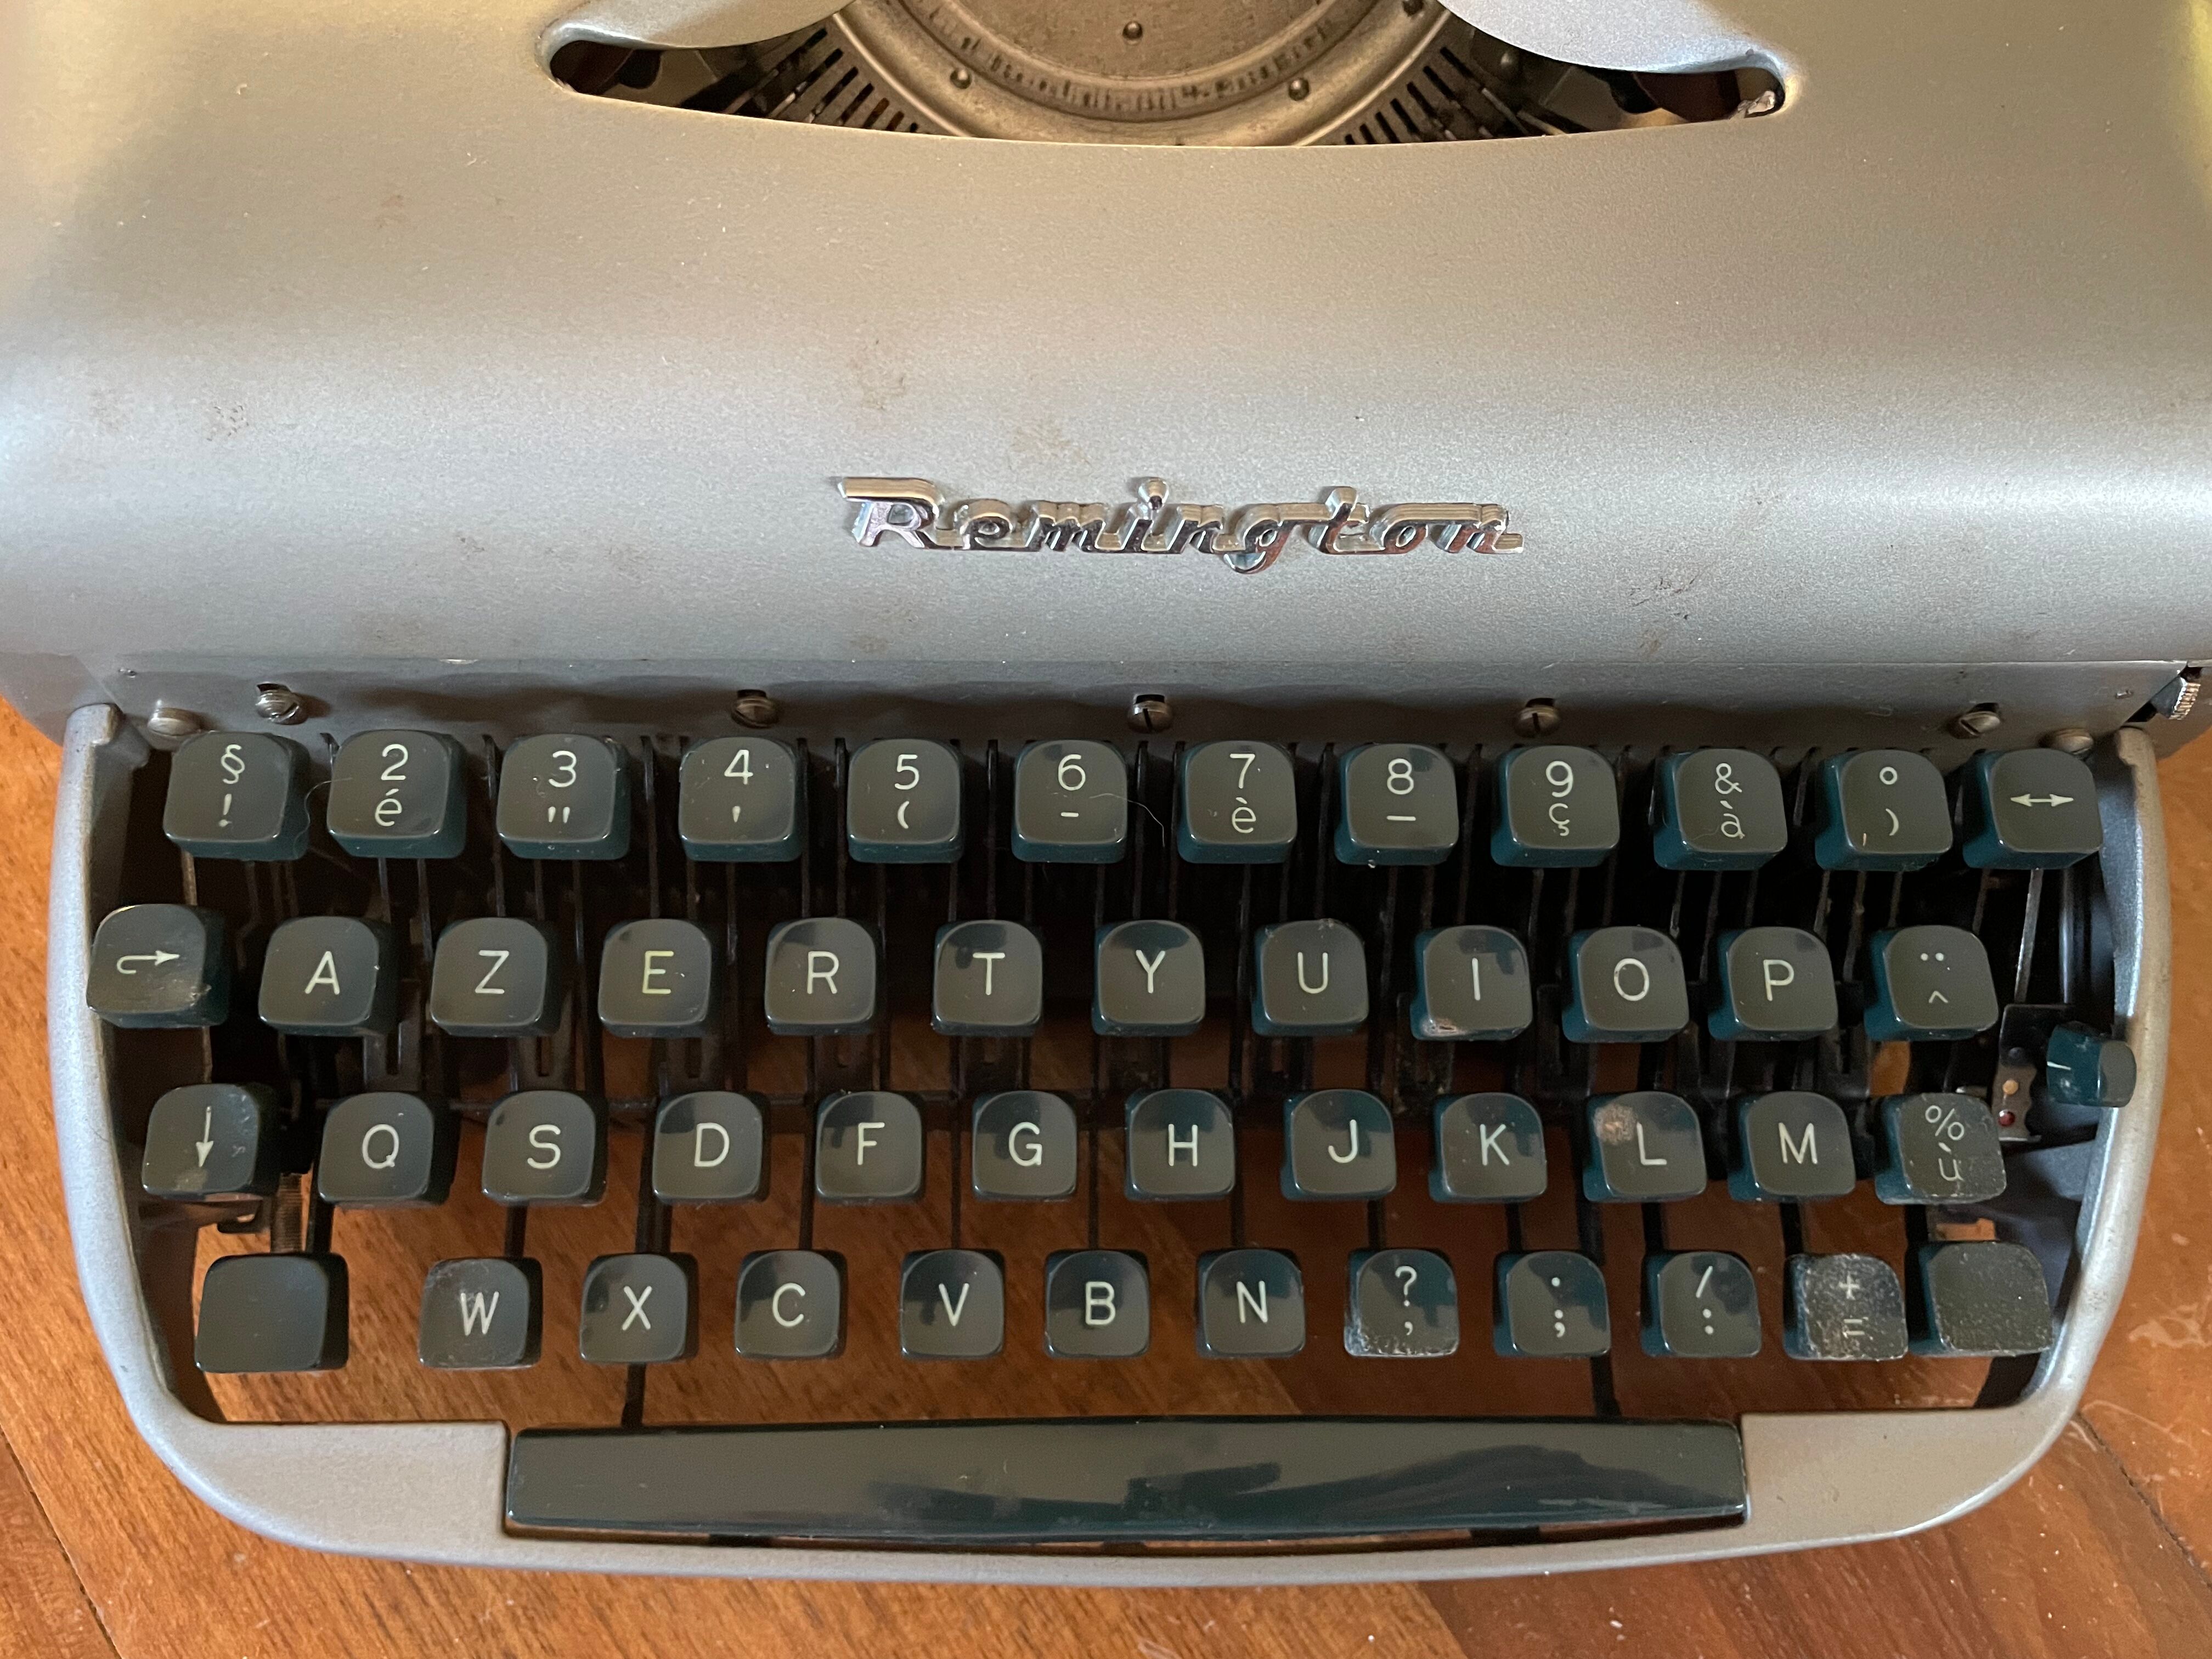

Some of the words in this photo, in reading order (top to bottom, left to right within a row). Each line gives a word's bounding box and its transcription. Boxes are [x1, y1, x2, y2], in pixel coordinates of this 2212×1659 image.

[837, 476, 1525, 574] Remington
[221, 744, 245, 785] §
[381, 743, 408, 781] 2
[549, 751, 577, 787] 3
[724, 749, 753, 785] 4
[894, 754, 919, 790] 5
[1058, 754, 1086, 791] 6
[1229, 753, 1255, 789] 7
[1387, 758, 1414, 795] 8
[1545, 761, 1573, 798] 9
[1715, 763, 1742, 794] &
[219, 793, 232, 827] !
[375, 788, 402, 826] é
[898, 800, 910, 829] (
[1232, 797, 1256, 833] è
[1549, 803, 1570, 836] ç
[1720, 800, 1745, 839] à
[1886, 808, 1899, 836] )
[305, 951, 340, 995] A
[475, 950, 509, 994] Z
[642, 951, 674, 994] E
[807, 951, 839, 994] R
[973, 952, 1006, 996] T
[1136, 950, 1166, 994] Y
[1297, 952, 1328, 994] U
[1613, 958, 1650, 1001] O
[1763, 960, 1795, 1001] P
[857, 1122, 885, 1165] F
[1009, 1122, 1042, 1166] G
[1328, 1119, 1358, 1163] J
[1636, 1122, 1667, 1165] L
[1779, 1122, 1818, 1164] M
[1925, 1105, 1965, 1141] %
[362, 1124, 399, 1169] Q
[527, 1124, 561, 1169] S
[695, 1122, 730, 1167] D
[1168, 1124, 1198, 1167] H
[1480, 1124, 1510, 1166] K
[1237, 1280, 1268, 1323] N
[1395, 1266, 1417, 1307] ?
[1696, 1266, 1713, 1298] /
[1838, 1275, 1860, 1300] +
[460, 1291, 499, 1336] W
[622, 1286, 652, 1330] X
[772, 1283, 806, 1327] C
[939, 1283, 969, 1327] V
[1086, 1282, 1116, 1325] B
[1555, 1310, 1565, 1337] ;
[1703, 1308, 1714, 1334] :
